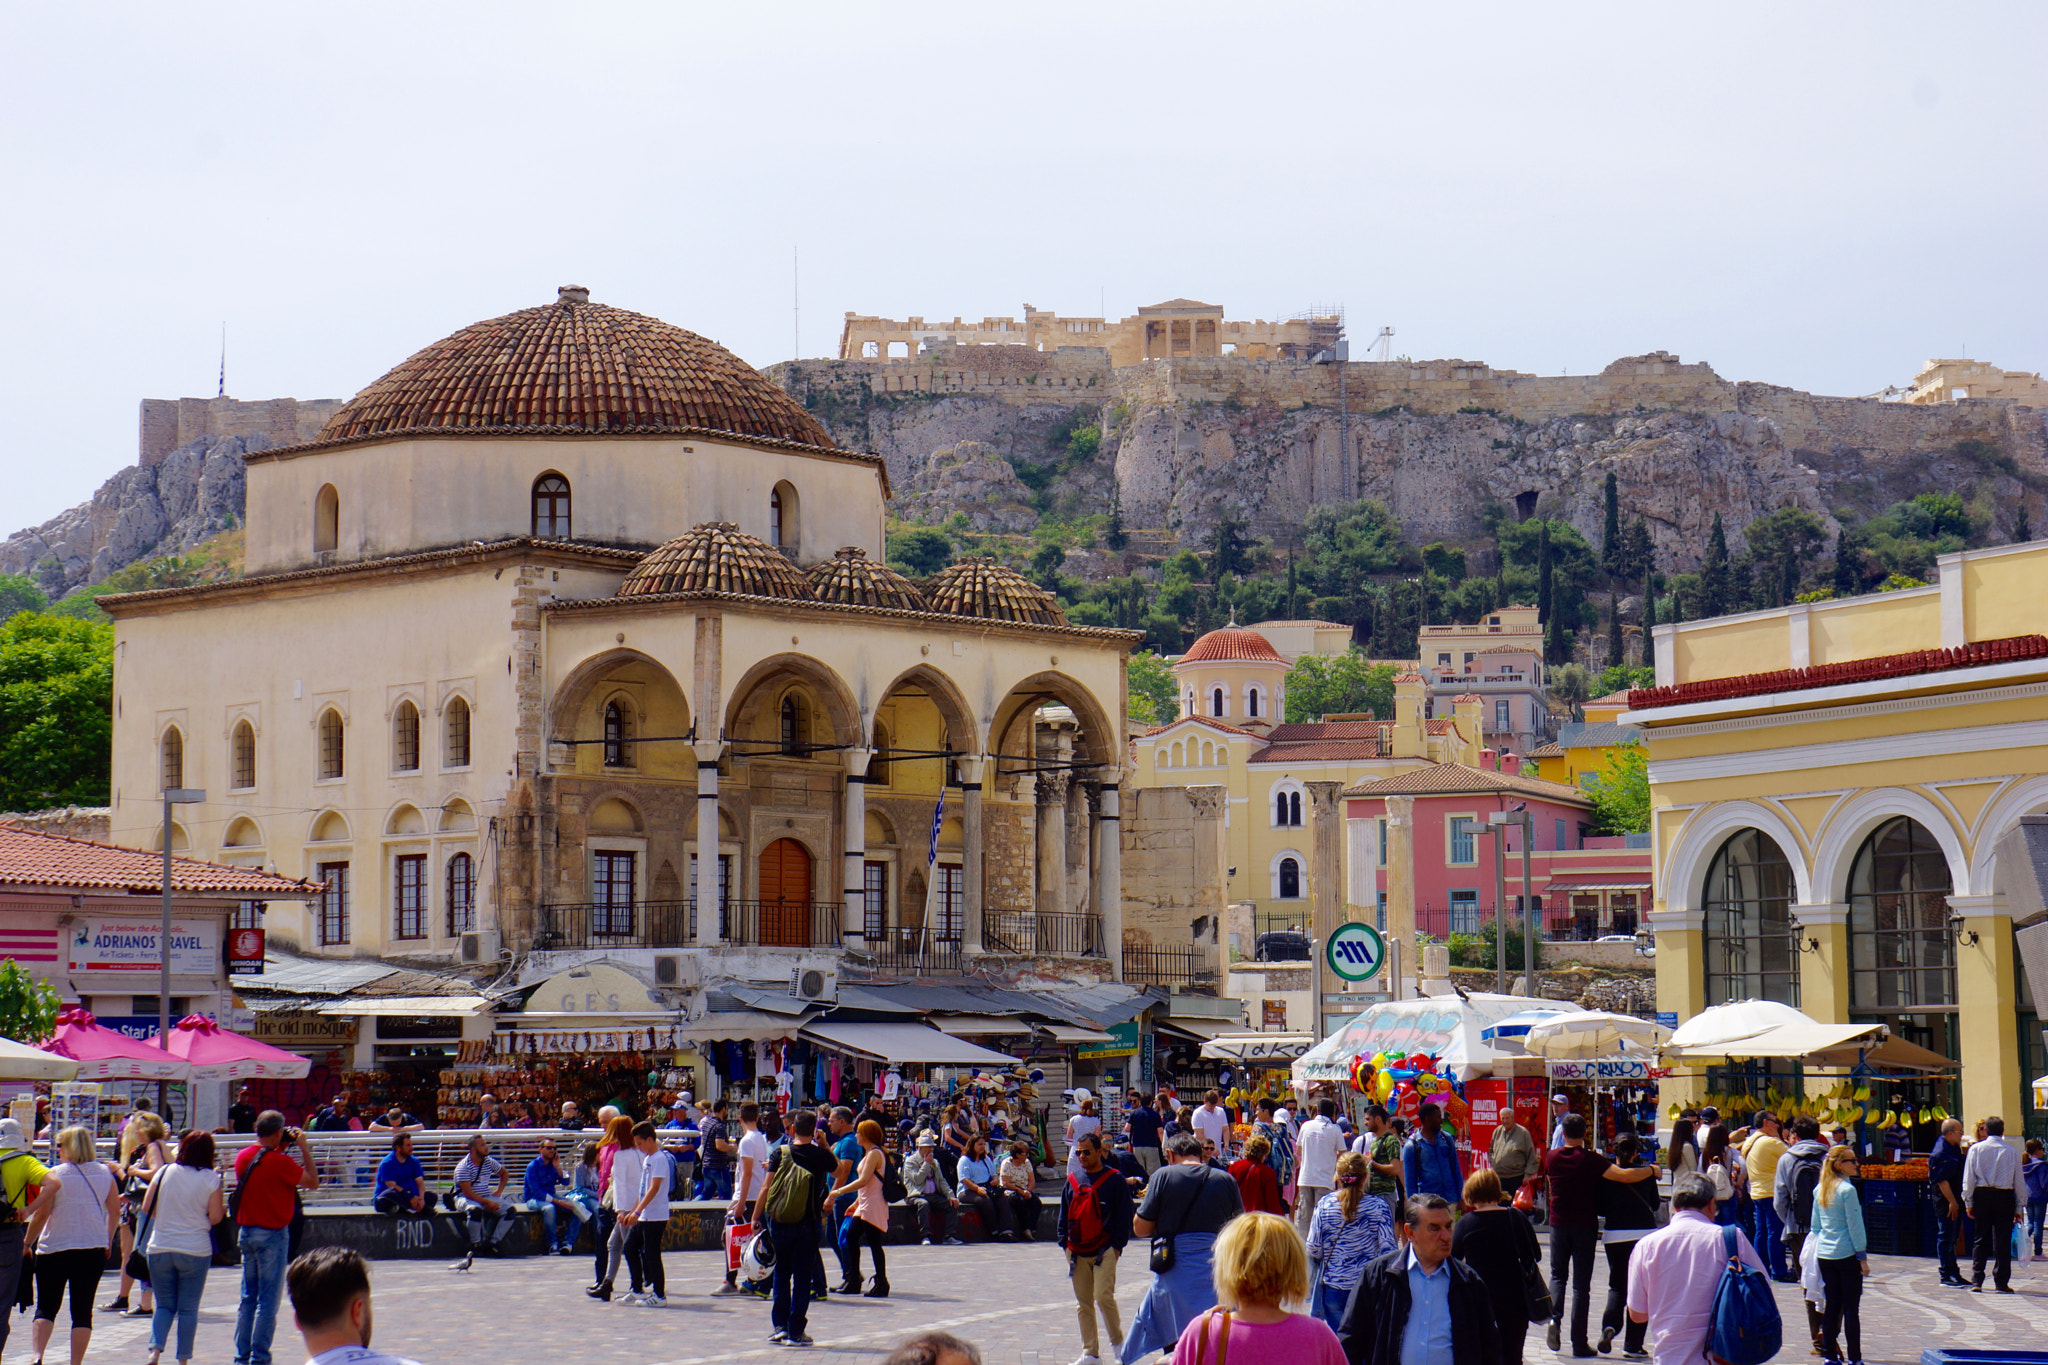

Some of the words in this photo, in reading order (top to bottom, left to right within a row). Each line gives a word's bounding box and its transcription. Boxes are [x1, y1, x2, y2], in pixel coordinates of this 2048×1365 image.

[115, 924, 136, 933] below
[138, 925, 149, 933] the
[93, 935, 156, 949] ADRIANOS
[160, 936, 202, 950] RAVEL
[112, 951, 134, 959] Tickets
[140, 951, 158, 960] Ferry
[254, 1020, 273, 1035] the
[278, 1020, 299, 1035] old
[1143, 1035, 1151, 1081] EXCHANGE
[396, 1219, 434, 1250] RND
